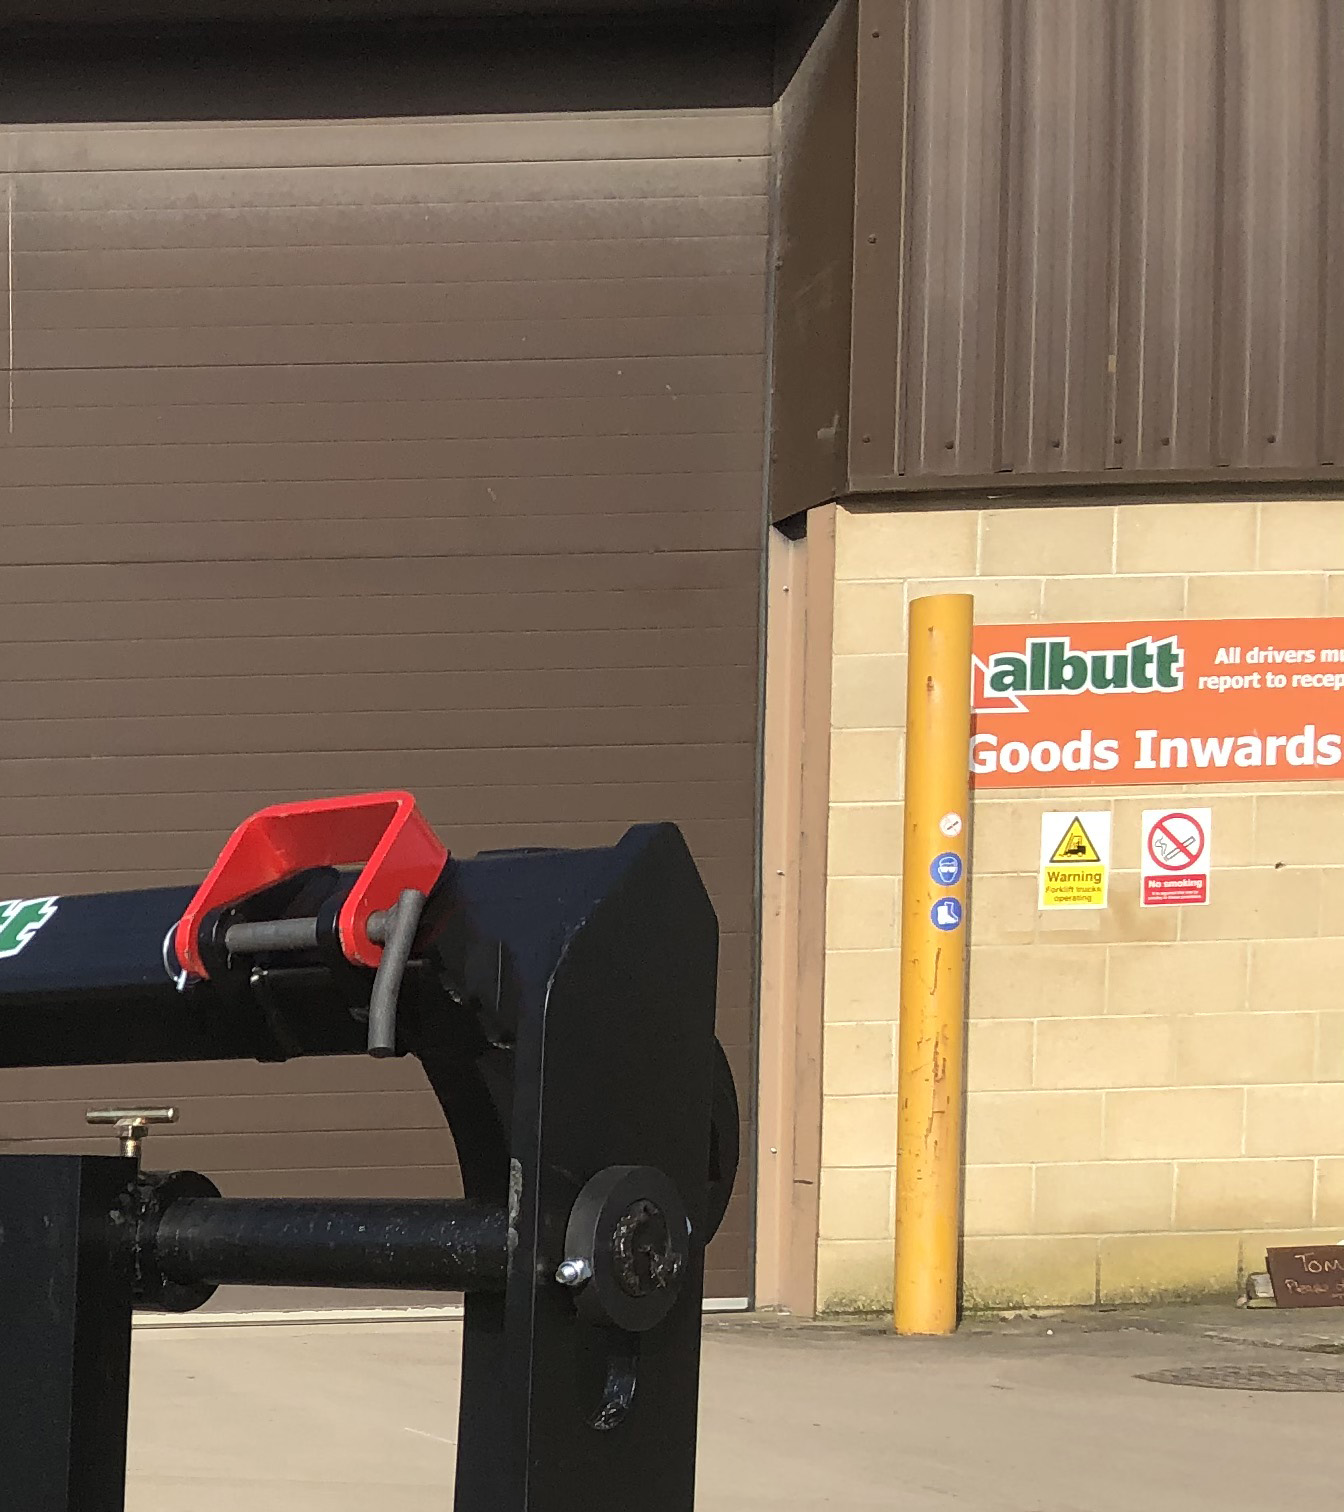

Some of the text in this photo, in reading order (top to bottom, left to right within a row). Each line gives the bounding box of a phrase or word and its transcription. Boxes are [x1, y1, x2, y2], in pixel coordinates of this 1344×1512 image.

[1214, 646, 1242, 665] All
[1245, 645, 1316, 664] drivers
[987, 639, 1183, 693] albutt
[1199, 671, 1261, 693] report
[1265, 671, 1287, 688] to
[970, 724, 1343, 774] Goods Inwards
[1047, 870, 1102, 885] Warning
[1148, 878, 1203, 889] No smoking
